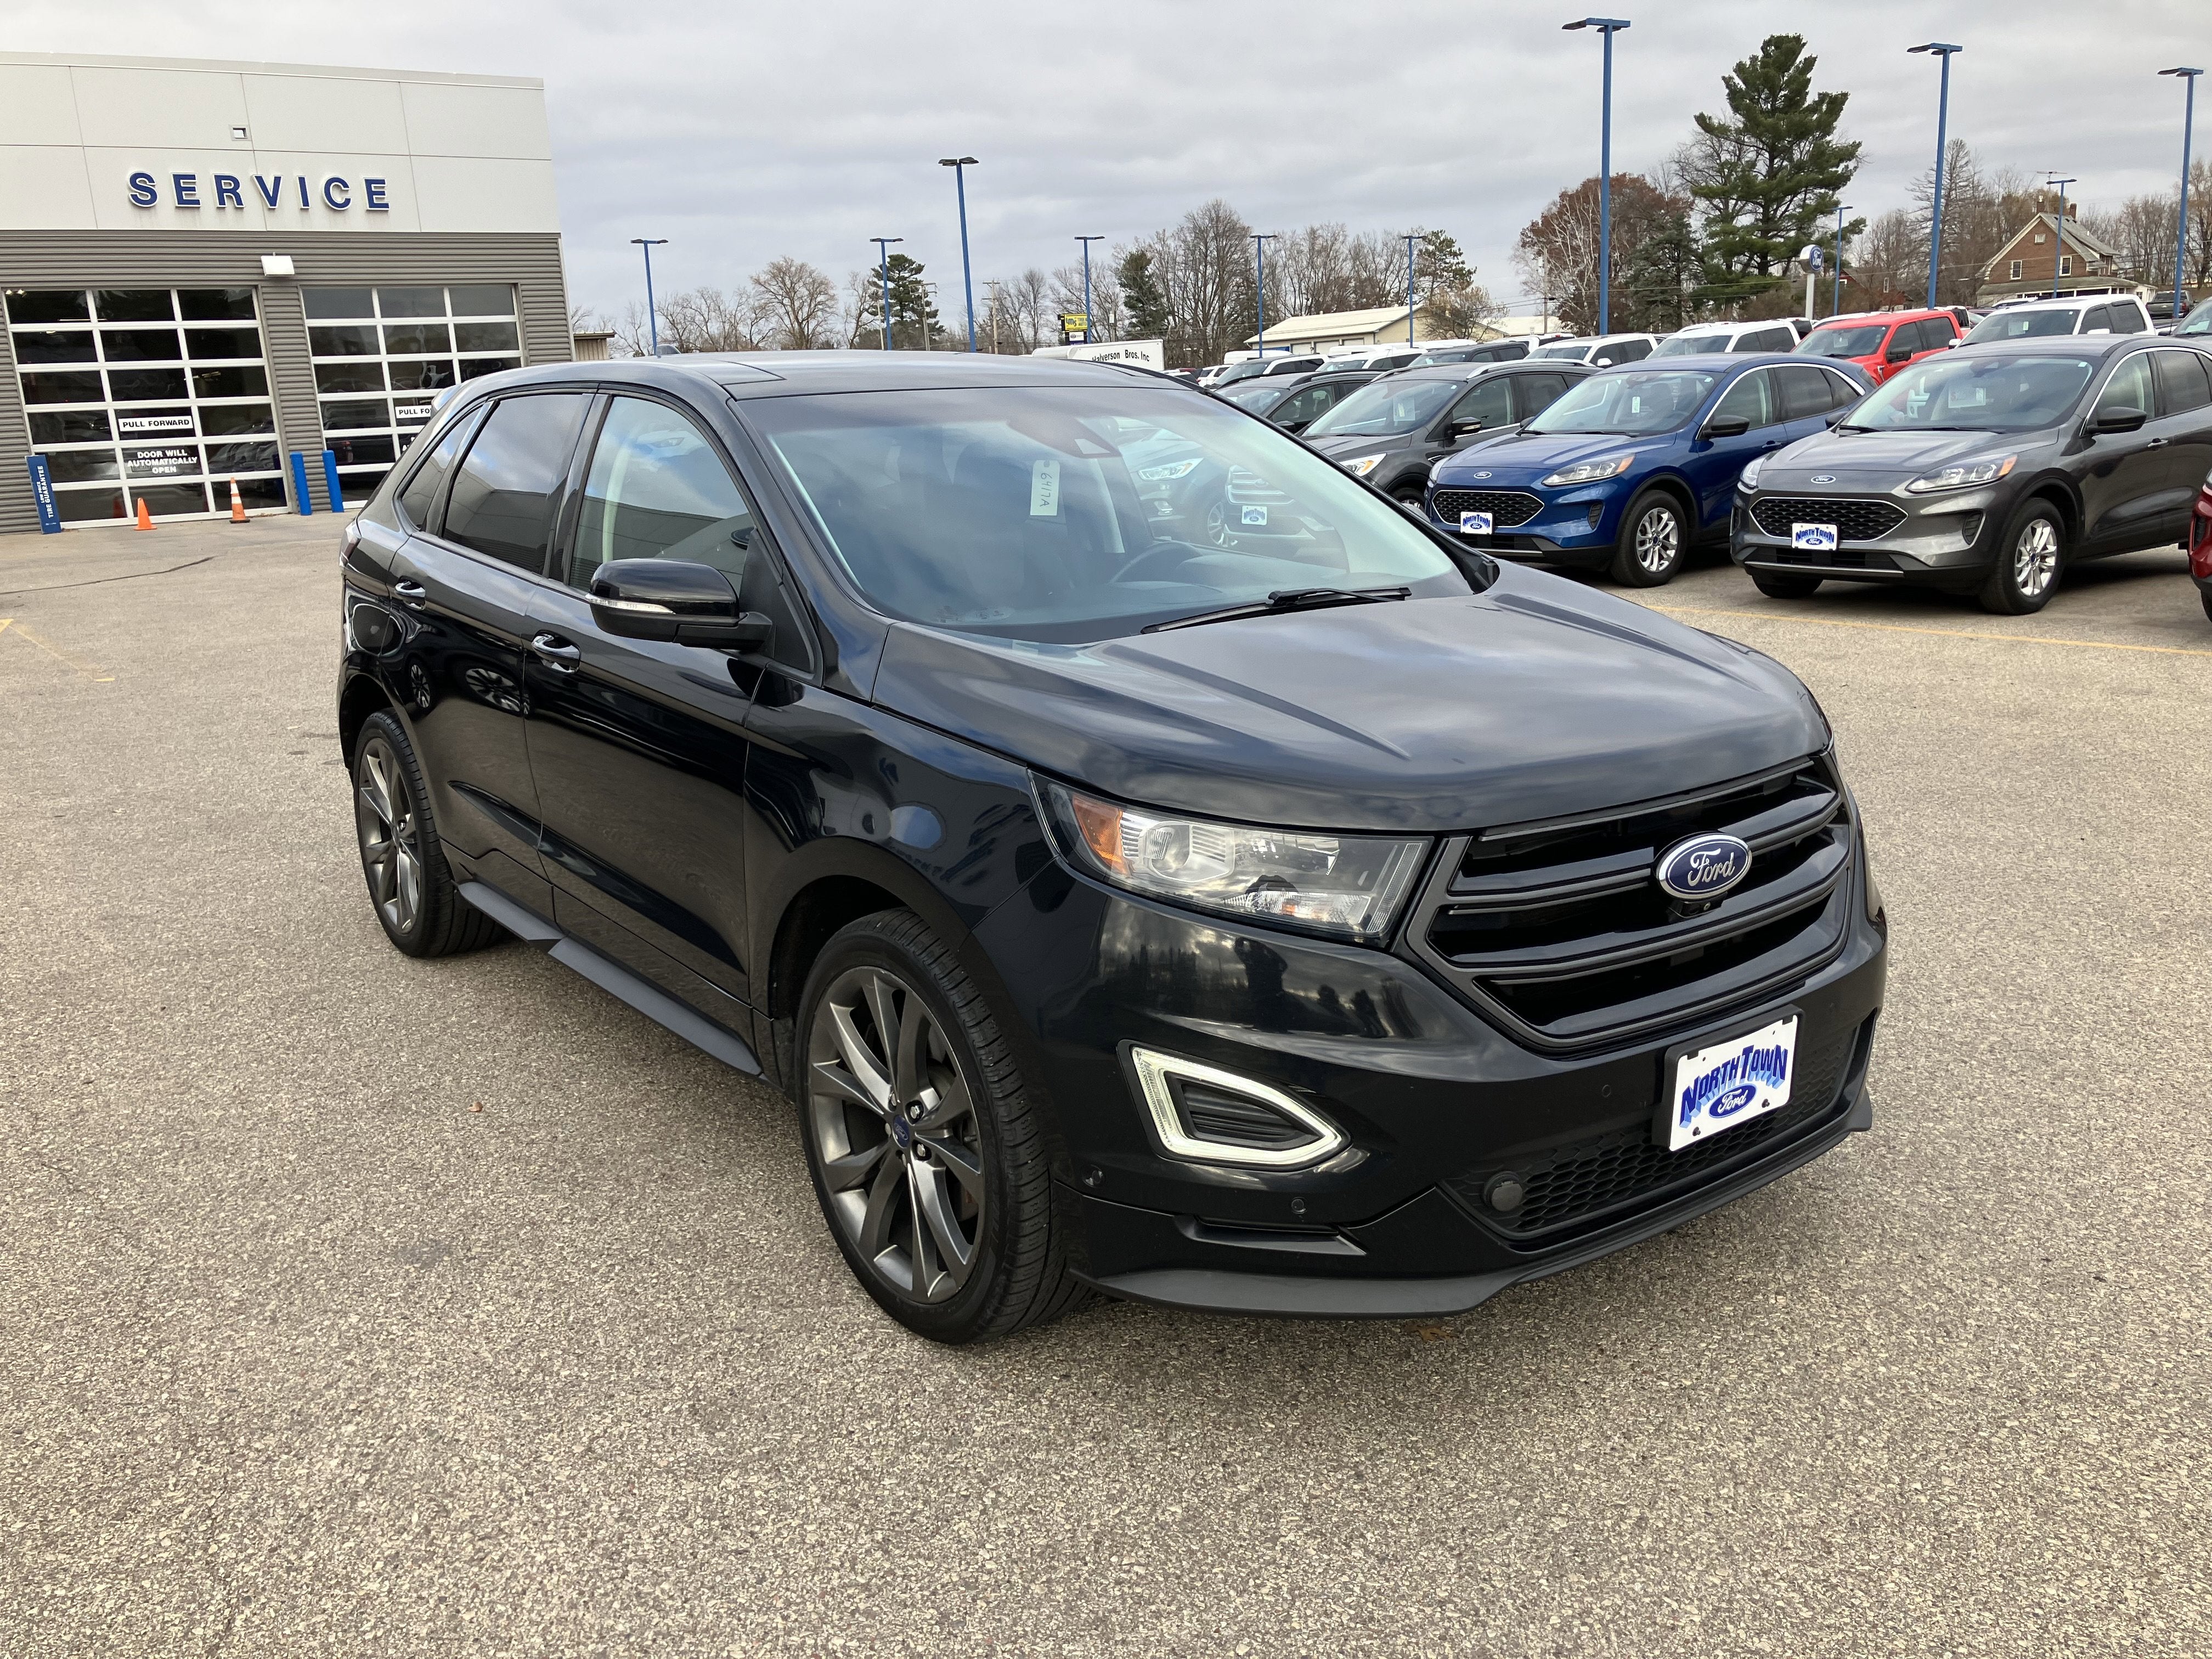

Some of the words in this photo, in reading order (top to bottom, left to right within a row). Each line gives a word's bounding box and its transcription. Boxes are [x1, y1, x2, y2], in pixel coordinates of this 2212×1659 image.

[128, 172, 390, 211] SERVICE
[1125, 349, 1139, 359] Bros.
[1141, 351, 1150, 362] Inc
[148, 419, 190, 427] FORWARD
[137, 450, 163, 459] DOOR
[165, 449, 188, 457] WILL
[127, 456, 198, 467] AUTOMATICALLY
[151, 466, 177, 474] OPEN
[37, 465, 50, 503] GUARANTEE
[1040, 472, 1053, 507] 6417A
[46, 504, 54, 518] TIRE
[1688, 848, 1735, 887] Ford
[1717, 1089, 1748, 1114] Ford
